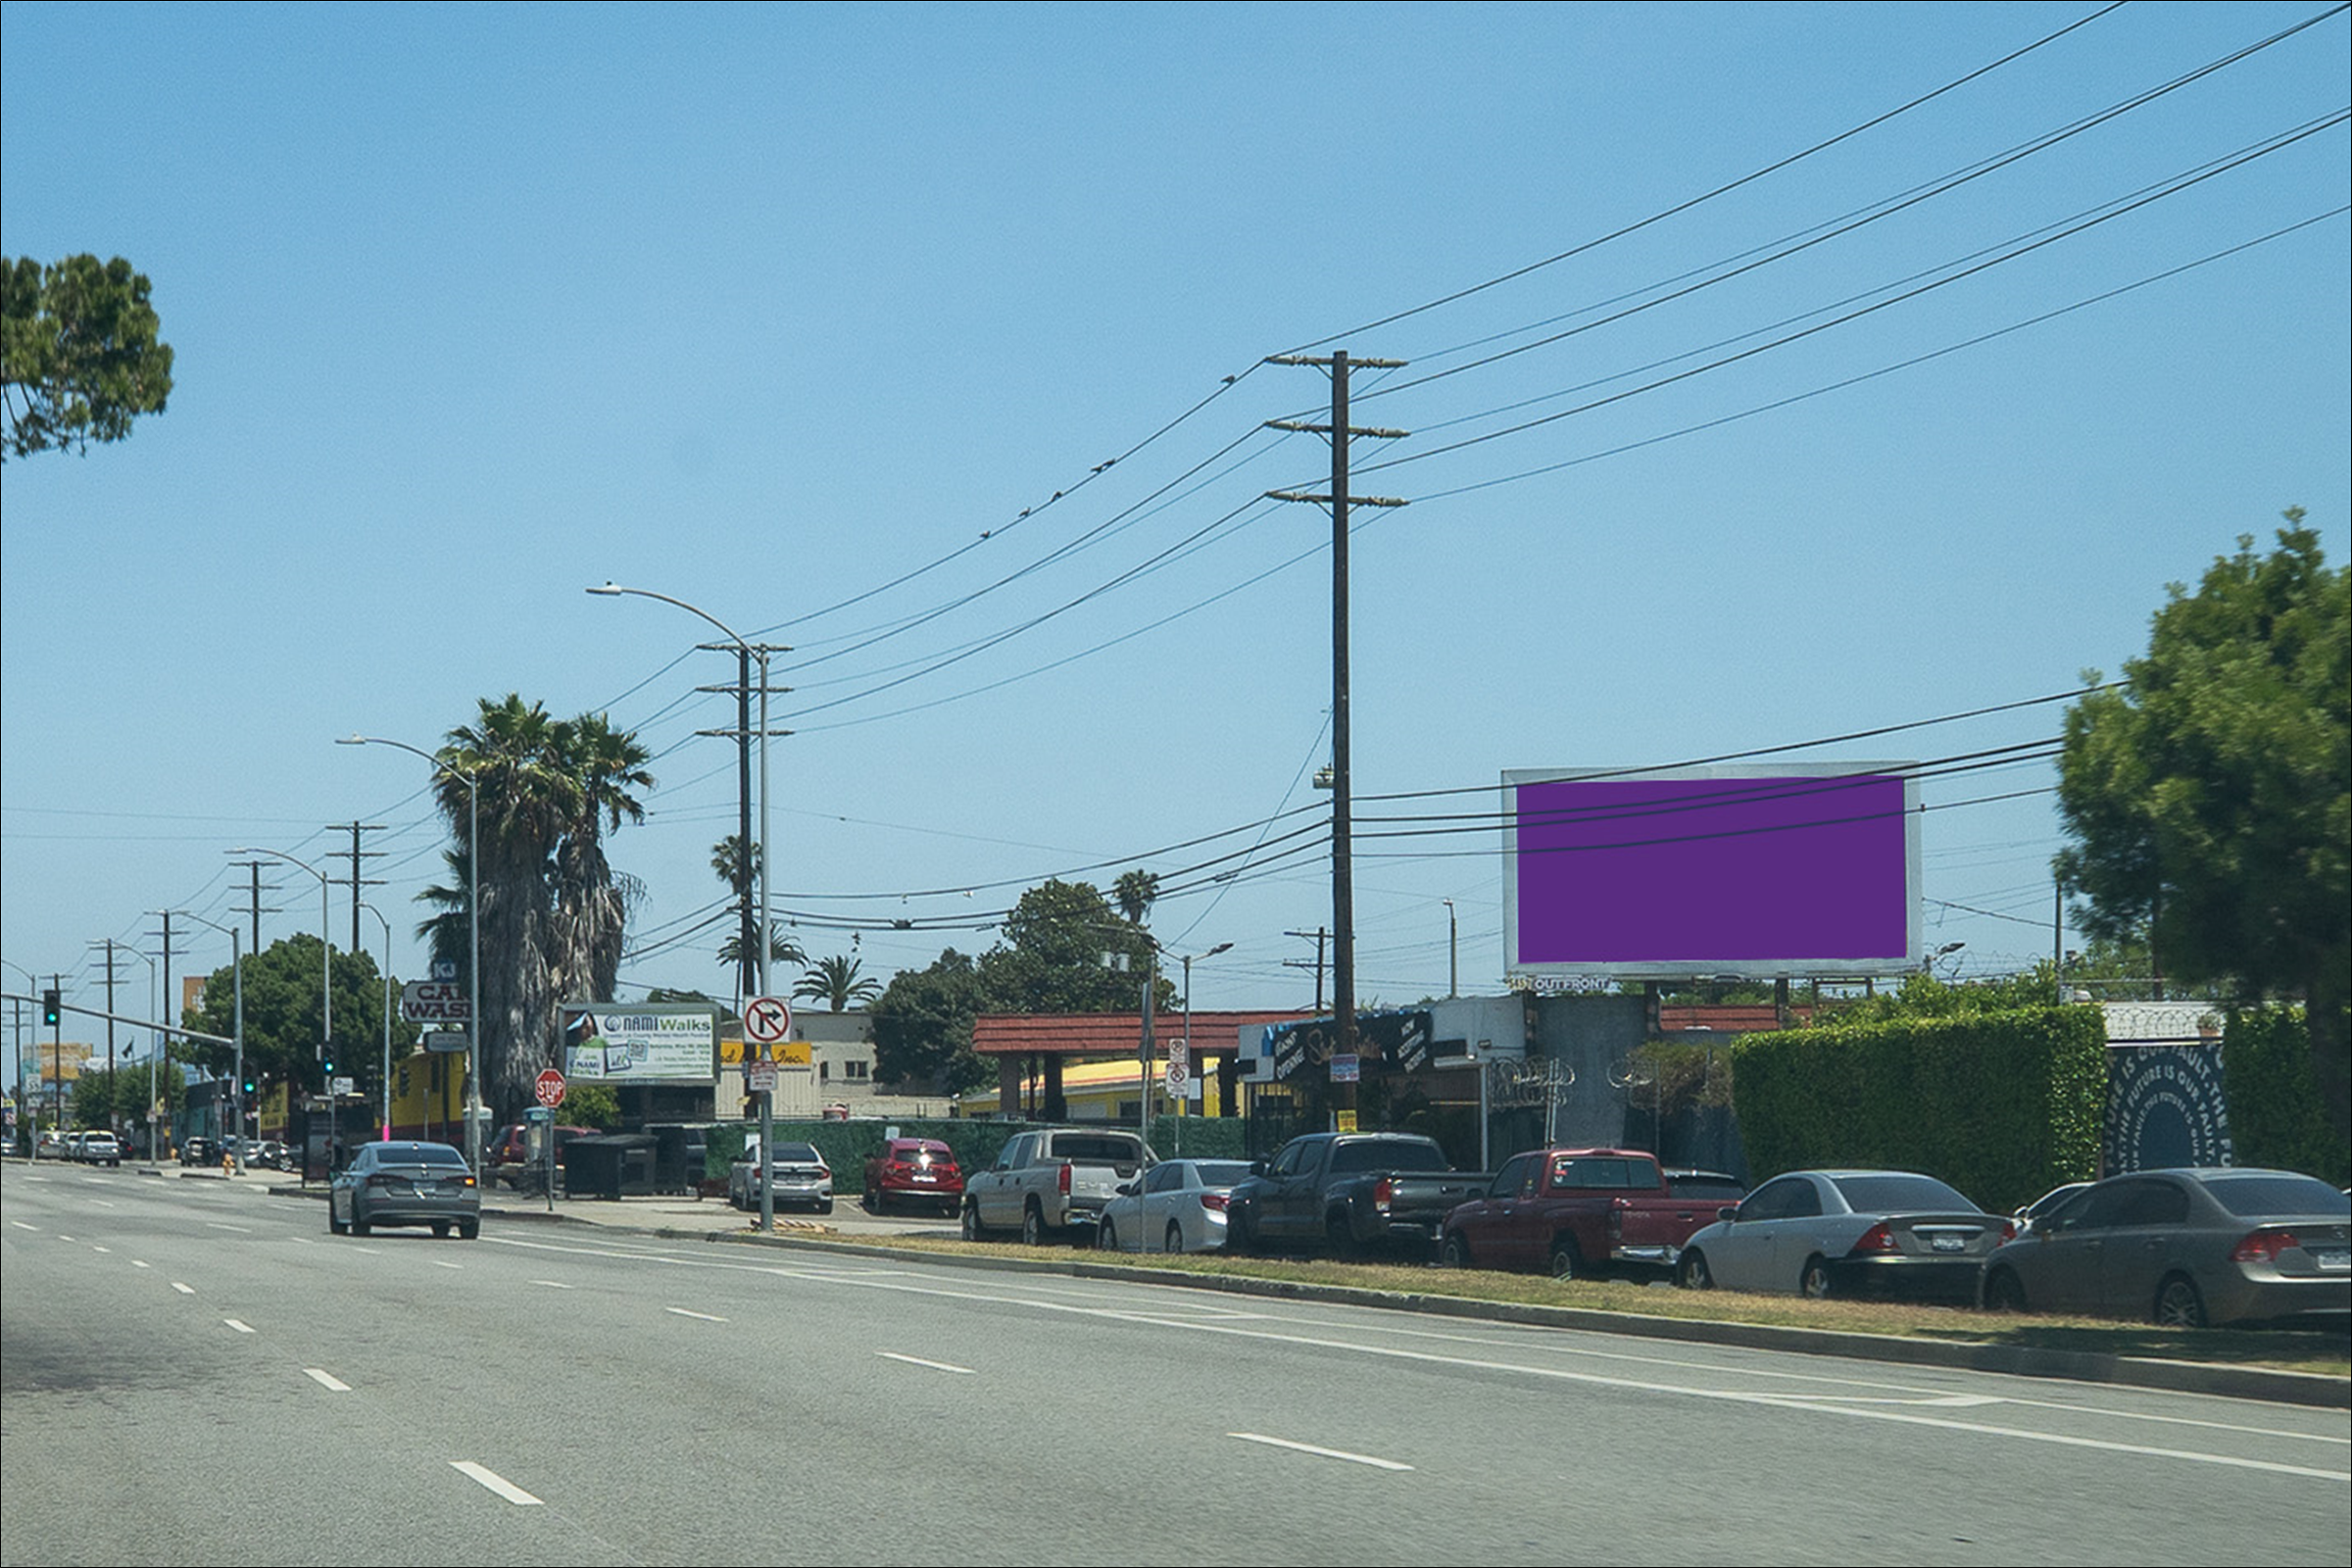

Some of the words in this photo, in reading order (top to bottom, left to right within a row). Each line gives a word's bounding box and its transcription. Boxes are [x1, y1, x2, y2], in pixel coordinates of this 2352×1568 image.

[538, 1081, 564, 1097] STOP
[2127, 1065, 2162, 1108] FUTURE
[2164, 1065, 2175, 1080] IS
[2178, 1070, 2200, 1102] OUR
